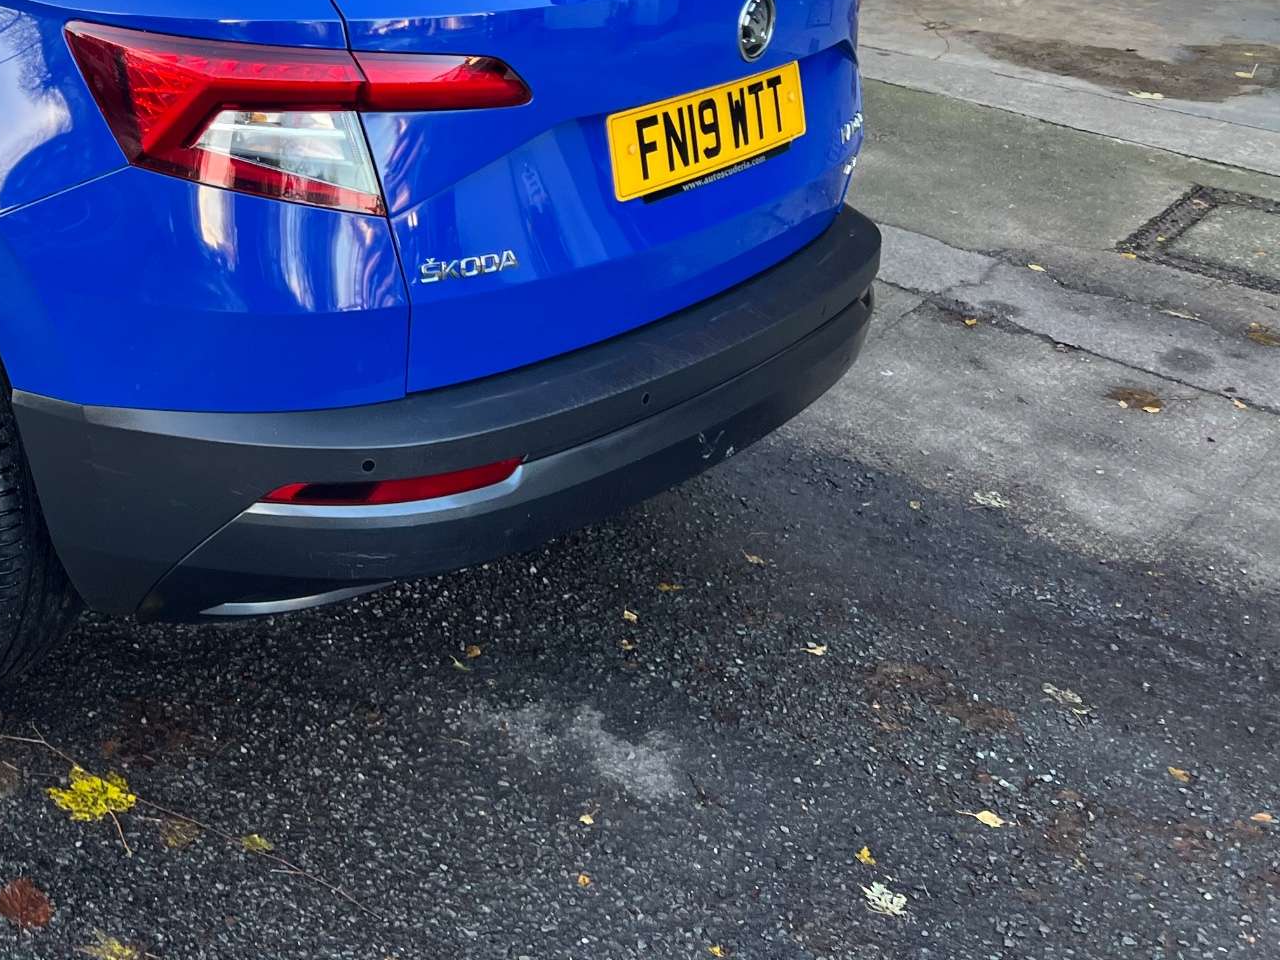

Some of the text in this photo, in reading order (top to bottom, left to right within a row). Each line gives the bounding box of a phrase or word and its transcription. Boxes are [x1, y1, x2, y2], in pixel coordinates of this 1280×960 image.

[636, 98, 721, 180] FN19
[727, 75, 782, 149] WTT
[682, 155, 767, 192] www.autoscuderia.com
[420, 249, 518, 284] ŠKODA
